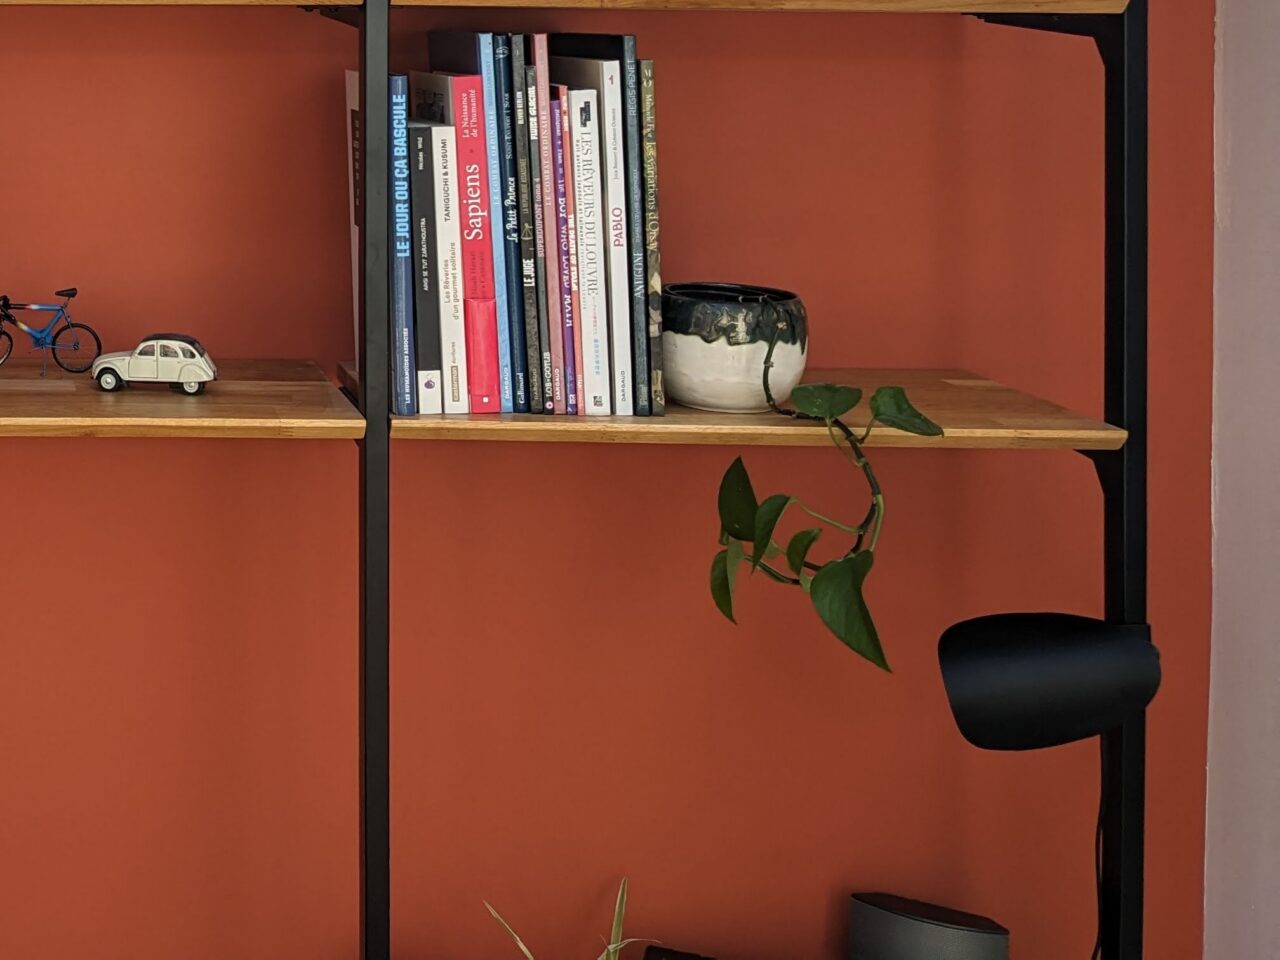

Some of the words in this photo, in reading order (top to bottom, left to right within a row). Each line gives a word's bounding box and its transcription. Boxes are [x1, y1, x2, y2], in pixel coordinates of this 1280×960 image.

[460, 93, 469, 127] Naissance
[467, 89, 478, 127] l'humanité
[391, 94, 408, 156] BASCULE
[462, 129, 469, 138] La
[470, 128, 478, 138] de
[488, 110, 497, 156] ORDINAIRE
[439, 138, 449, 169] KUSUMI
[581, 132, 592, 156] LES
[393, 158, 410, 178] ÇA
[490, 157, 500, 195] COMBAT
[442, 178, 451, 222] TANIGUCHI
[462, 163, 487, 240] Sapiens
[492, 197, 500, 205] LE
[505, 176, 517, 206] Prince
[581, 159, 596, 220] RÊVEURS
[395, 202, 410, 239] JOUR
[506, 209, 517, 230] Petit
[584, 221, 597, 241] DU
[612, 207, 624, 248] PABLO
[396, 240, 410, 257] LE
[508, 232, 518, 243] Le
[523, 258, 535, 276] JUGE
[524, 276, 535, 287] LE
[586, 243, 599, 296] LOUVRE
[632, 250, 645, 300] ANTIGONE
